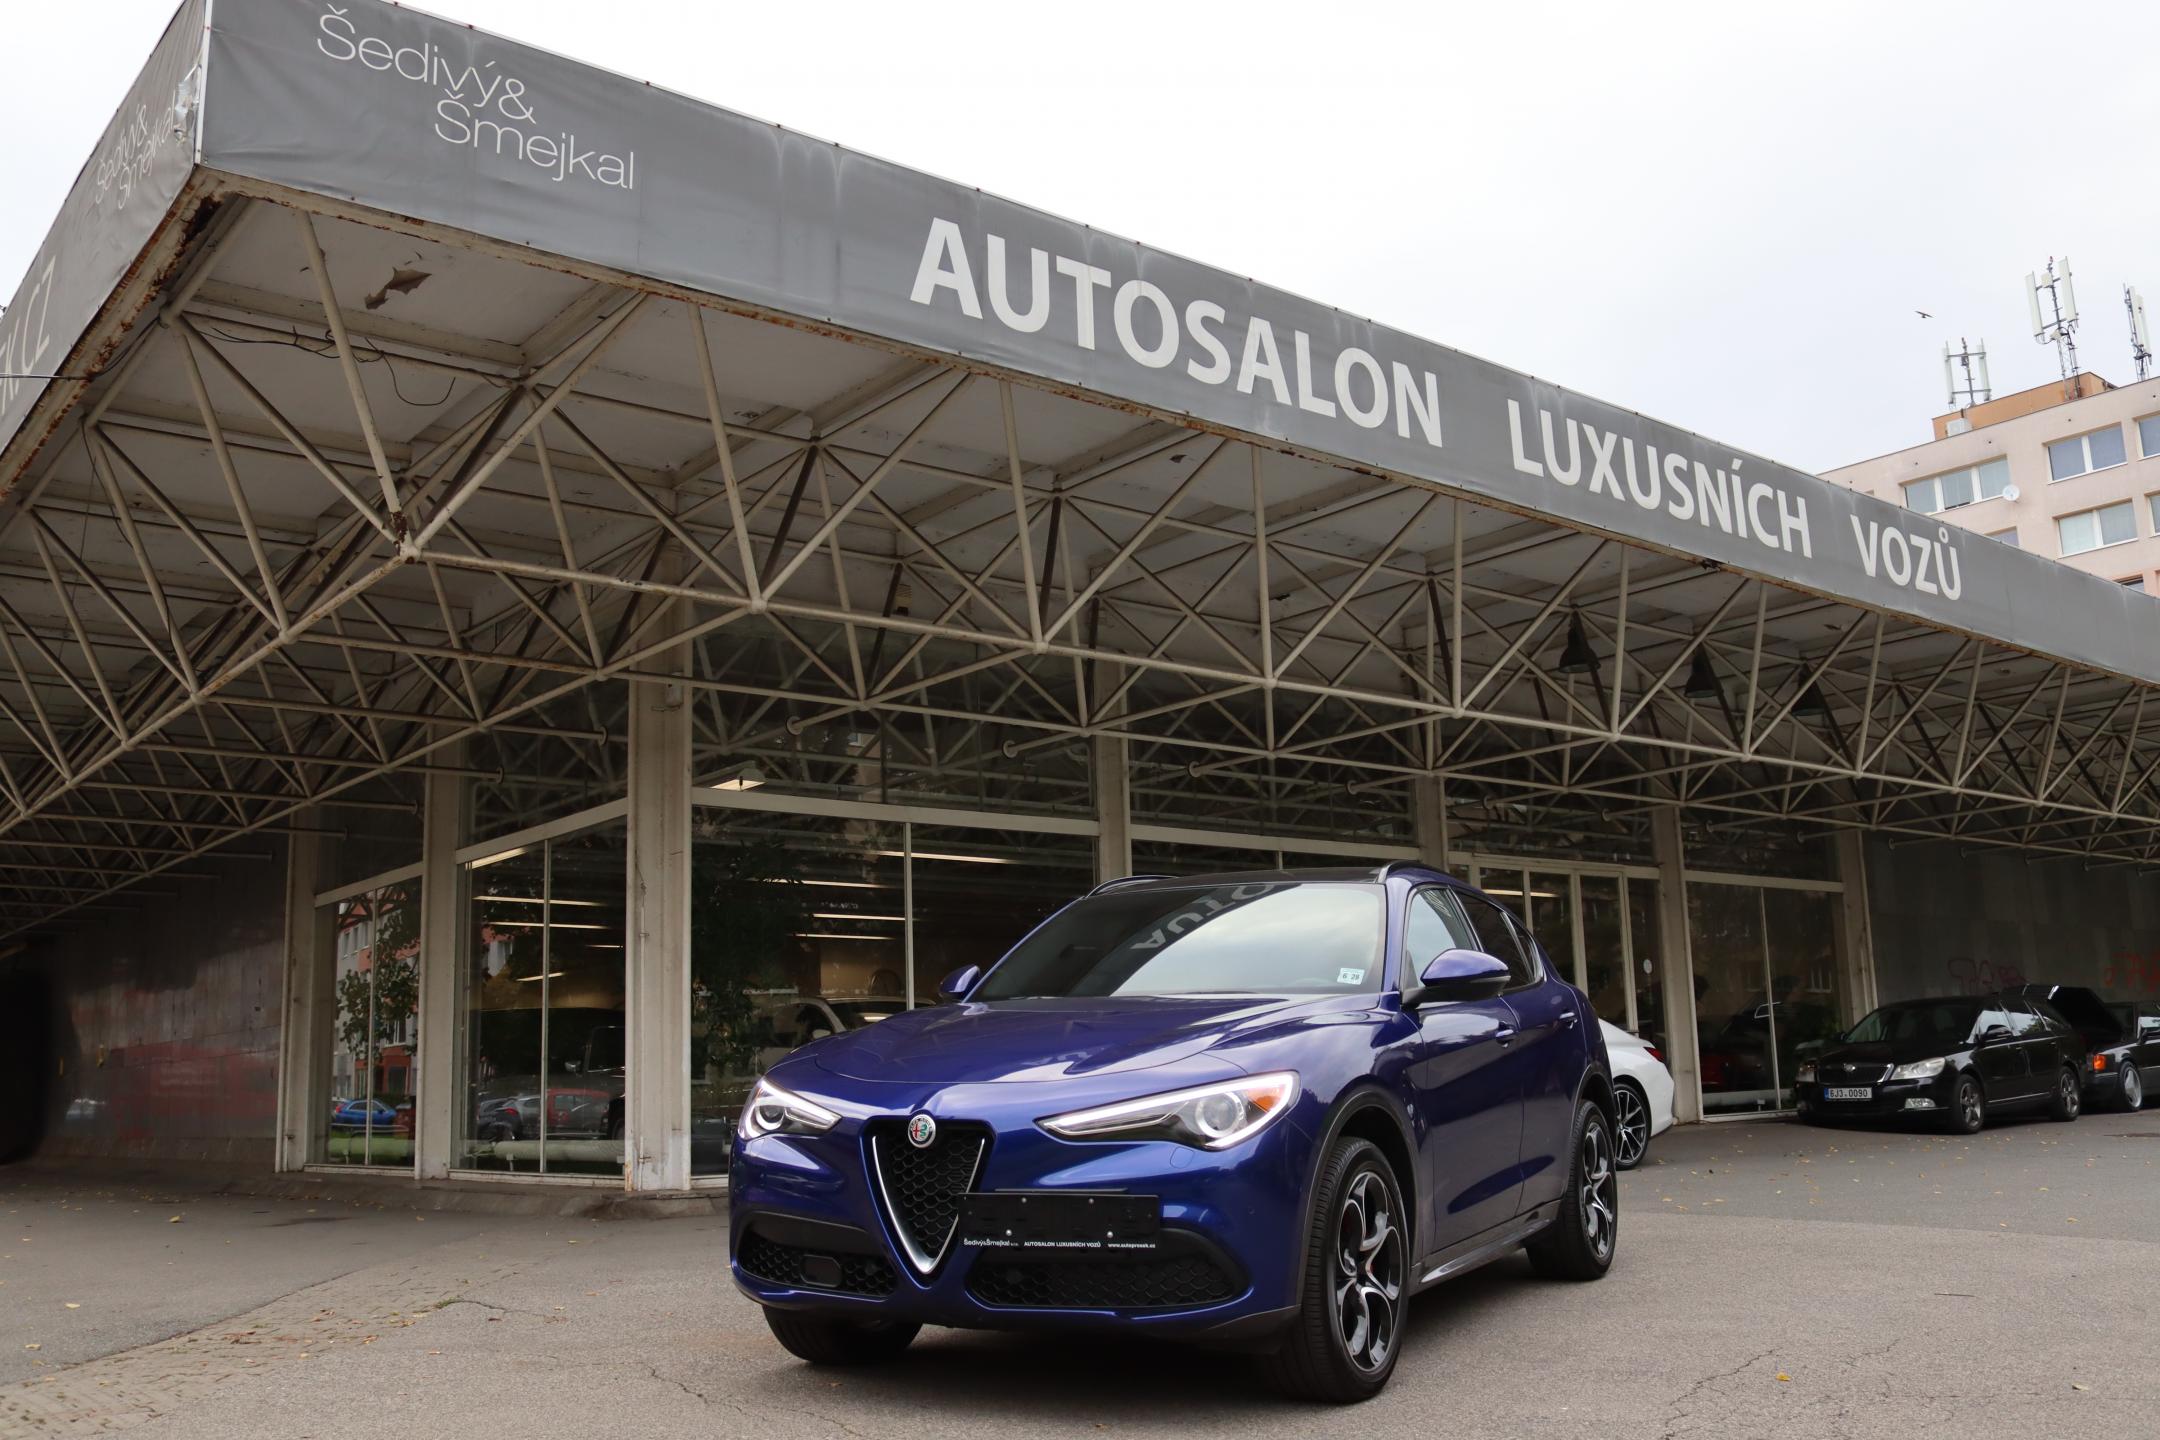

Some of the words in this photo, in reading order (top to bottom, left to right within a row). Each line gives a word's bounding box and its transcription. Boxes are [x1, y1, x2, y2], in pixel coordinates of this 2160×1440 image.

[316, 3, 535, 124] Šedivý&
[434, 88, 636, 191] Šmejkal
[909, 216, 1444, 448] AUTOSALON
[1506, 398, 1813, 559] LUXUSNÍCH
[1849, 513, 1962, 602] VOZŮ
